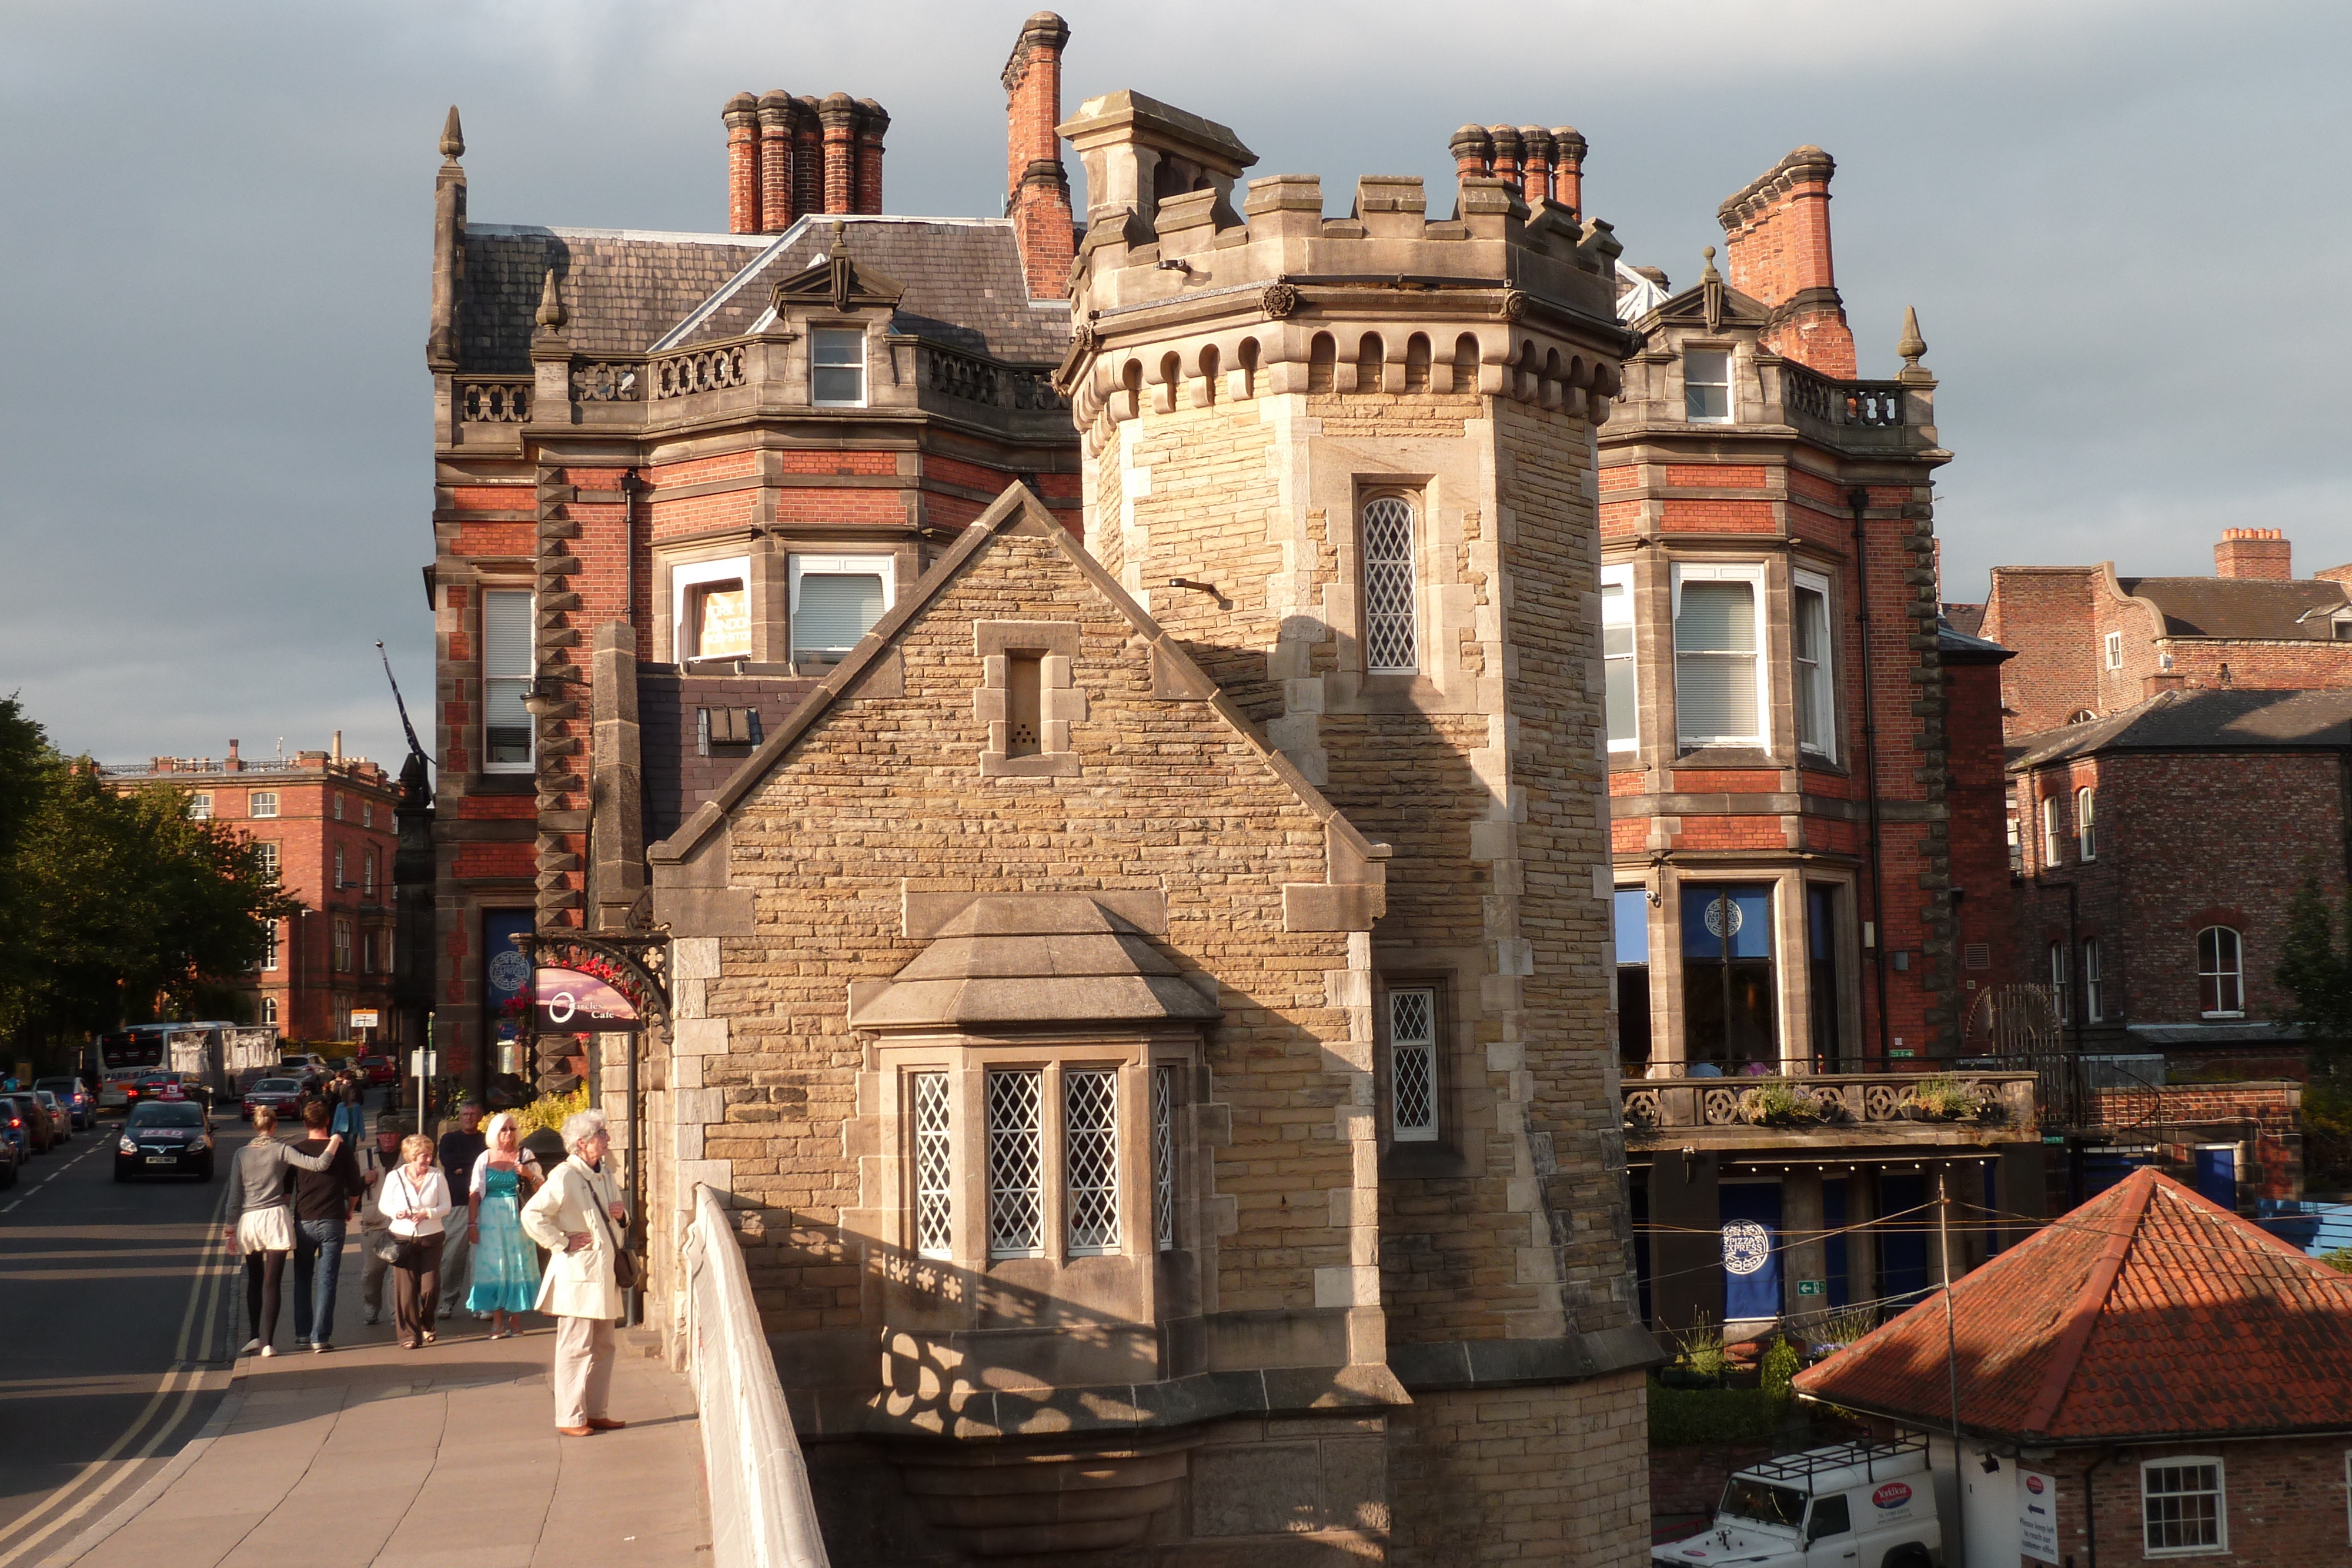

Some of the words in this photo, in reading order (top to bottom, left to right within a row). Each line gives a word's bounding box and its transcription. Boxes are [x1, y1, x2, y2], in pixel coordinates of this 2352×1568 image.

[1729, 1237, 1756, 1245] PIZZA
[1723, 1243, 1762, 1252] EXPRESS
[2019, 1516, 2034, 1528] Please
[2030, 1532, 2042, 1540] reach
